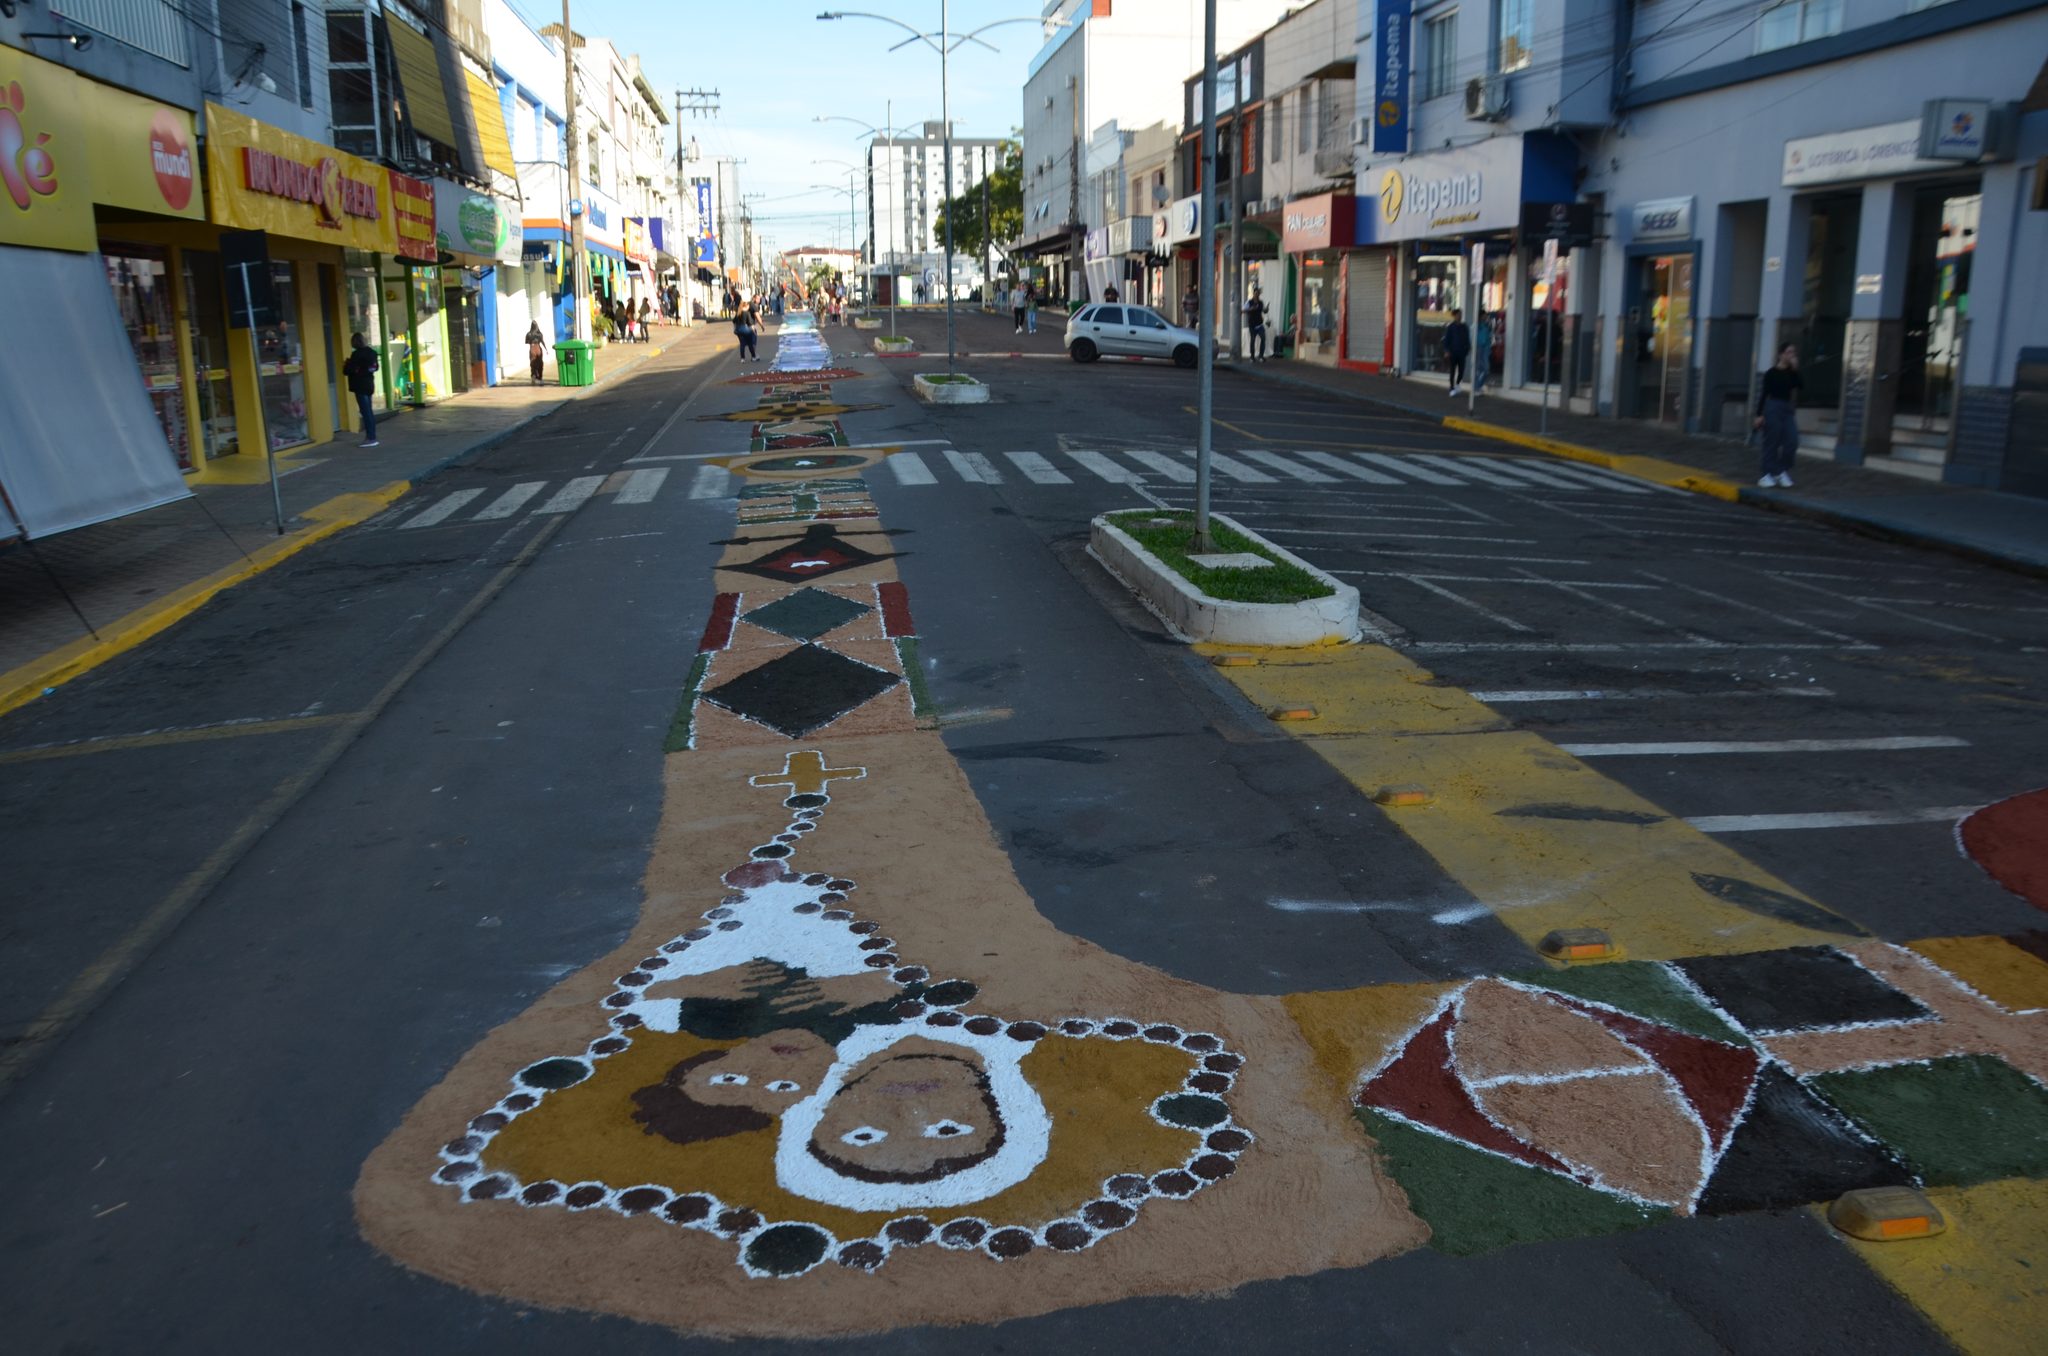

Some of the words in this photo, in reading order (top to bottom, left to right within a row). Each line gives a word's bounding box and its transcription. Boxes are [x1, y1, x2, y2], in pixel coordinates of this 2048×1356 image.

[1381, 13, 1402, 96] itapema
[153, 148, 192, 179] mundi
[242, 147, 323, 205] MUNDO
[1405, 171, 1482, 220] itapema
